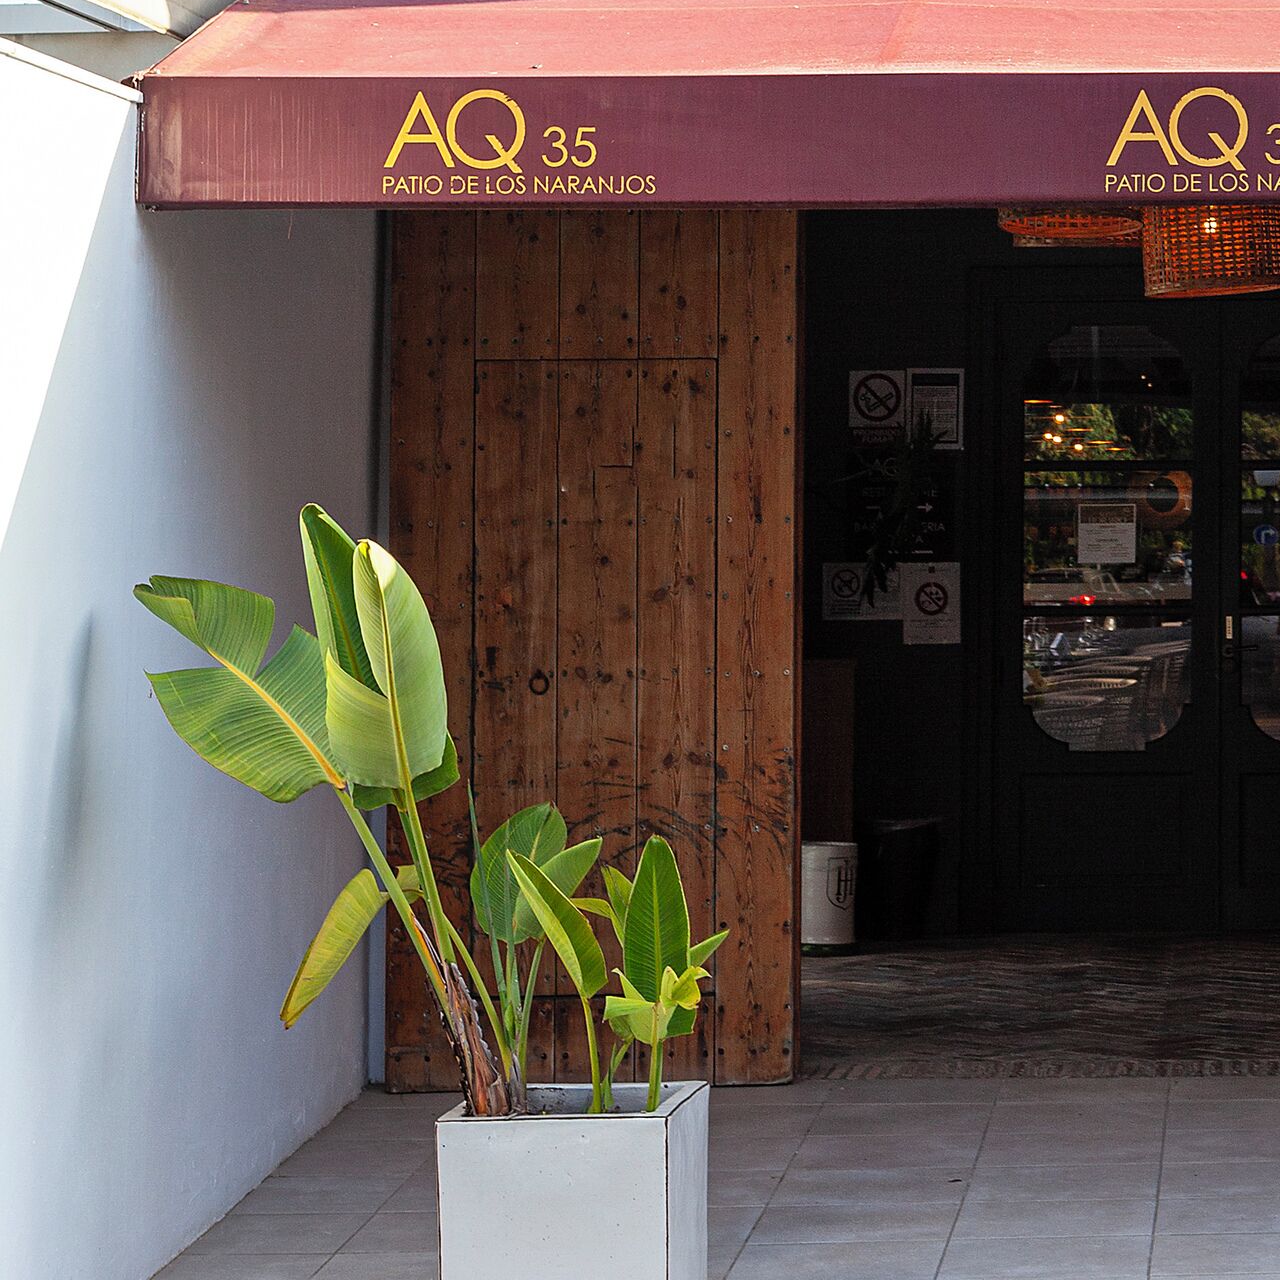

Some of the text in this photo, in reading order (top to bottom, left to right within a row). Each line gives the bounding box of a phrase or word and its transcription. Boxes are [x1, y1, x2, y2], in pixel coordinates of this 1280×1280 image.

[384, 89, 597, 174] AQ 35
[1106, 87, 1249, 171] AQ
[382, 175, 656, 195] PATIO DE LOS NARANJOS
[1104, 173, 1166, 193] PATIO
[1173, 173, 1202, 192] DE
[1209, 173, 1250, 192] LOS
